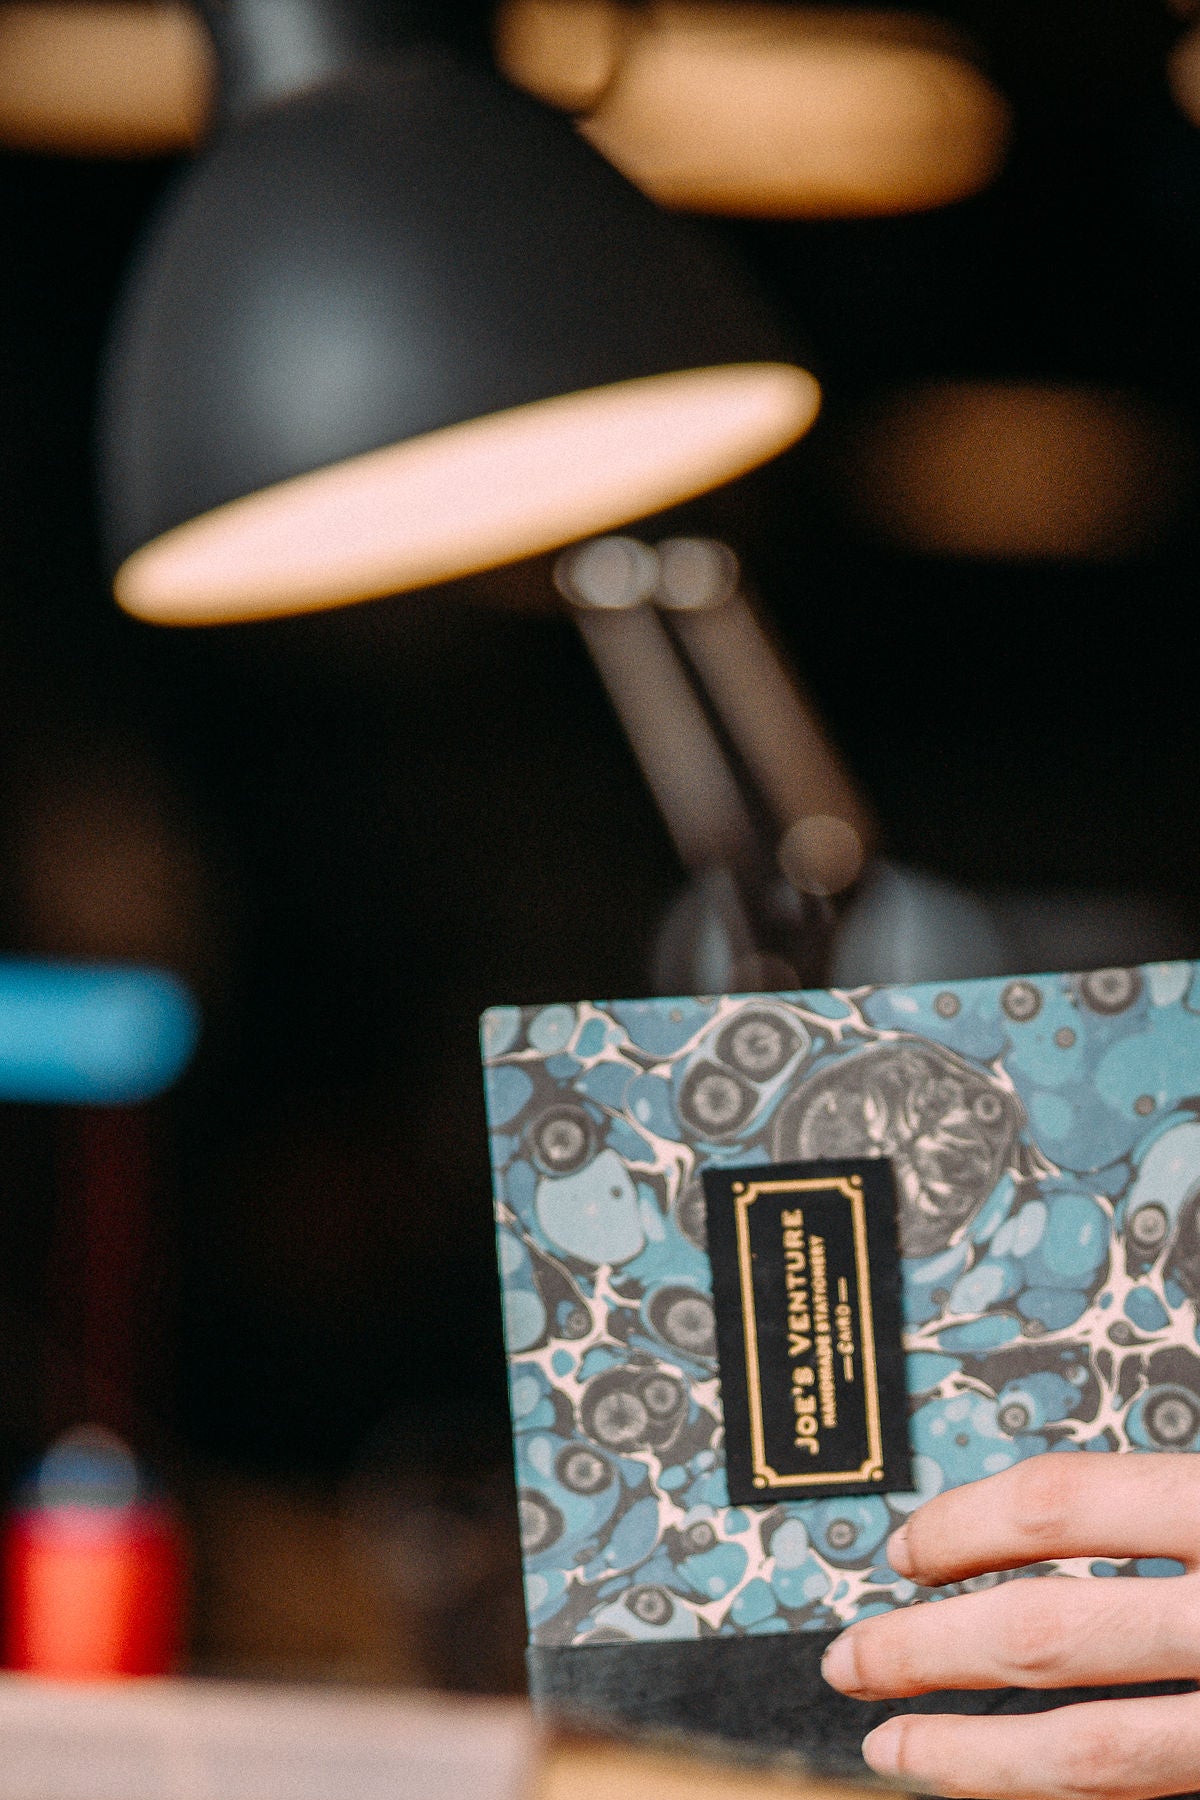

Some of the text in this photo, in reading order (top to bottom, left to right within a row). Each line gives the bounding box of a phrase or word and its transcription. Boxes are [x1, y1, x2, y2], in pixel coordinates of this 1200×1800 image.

[780, 1208, 820, 1456] JOE'S VENTURE
[808, 1234, 837, 1428] HANDMADE STATIONERY
[834, 1303, 854, 1356] CAIRO
